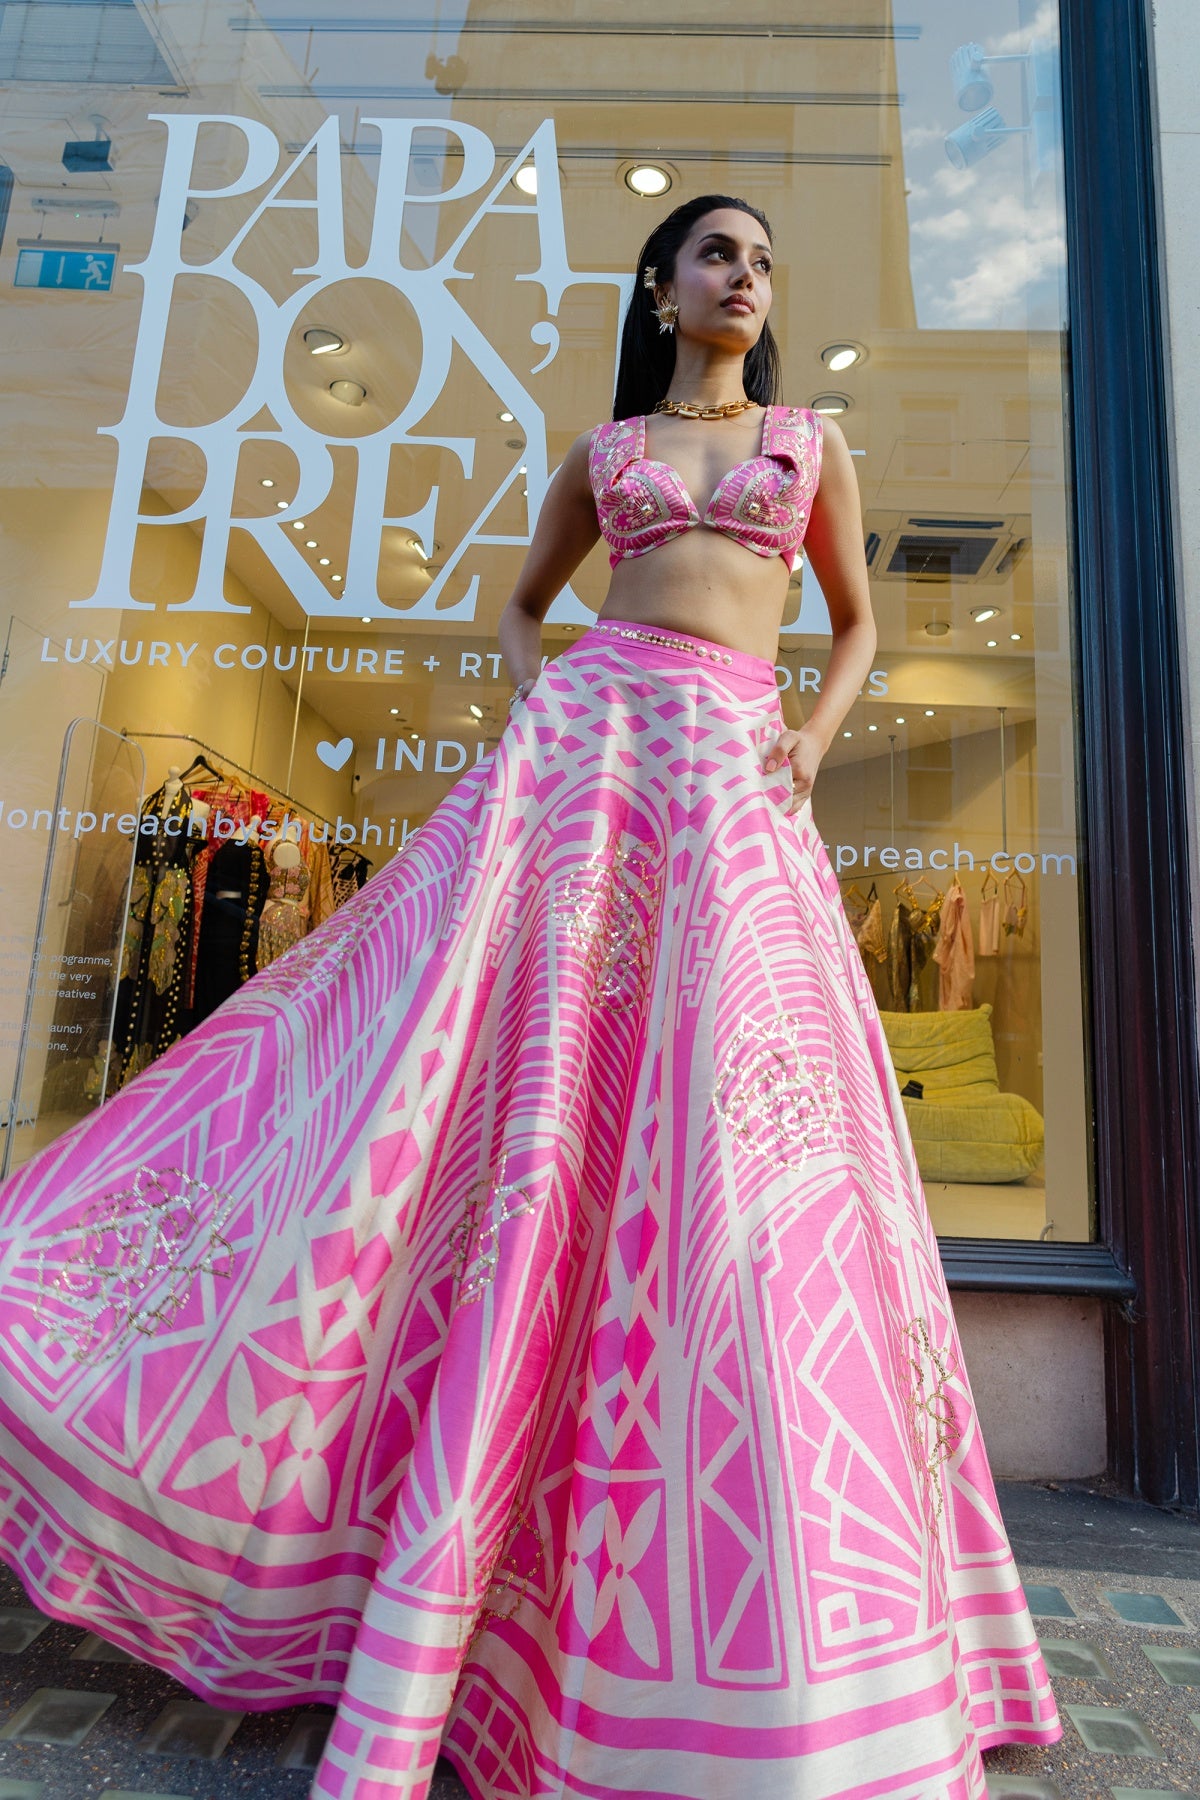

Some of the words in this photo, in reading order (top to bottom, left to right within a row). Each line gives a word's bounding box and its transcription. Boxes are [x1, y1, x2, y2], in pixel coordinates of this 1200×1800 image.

[123, 114, 580, 280] PAPA
[40, 637, 199, 667] LUXURY
[213, 642, 404, 676] COUTURE
[423, 655, 440, 672] +
[823, 842, 1076, 875] preach.com
[70, 973, 93, 984] very
[47, 1041, 70, 1052] one.
